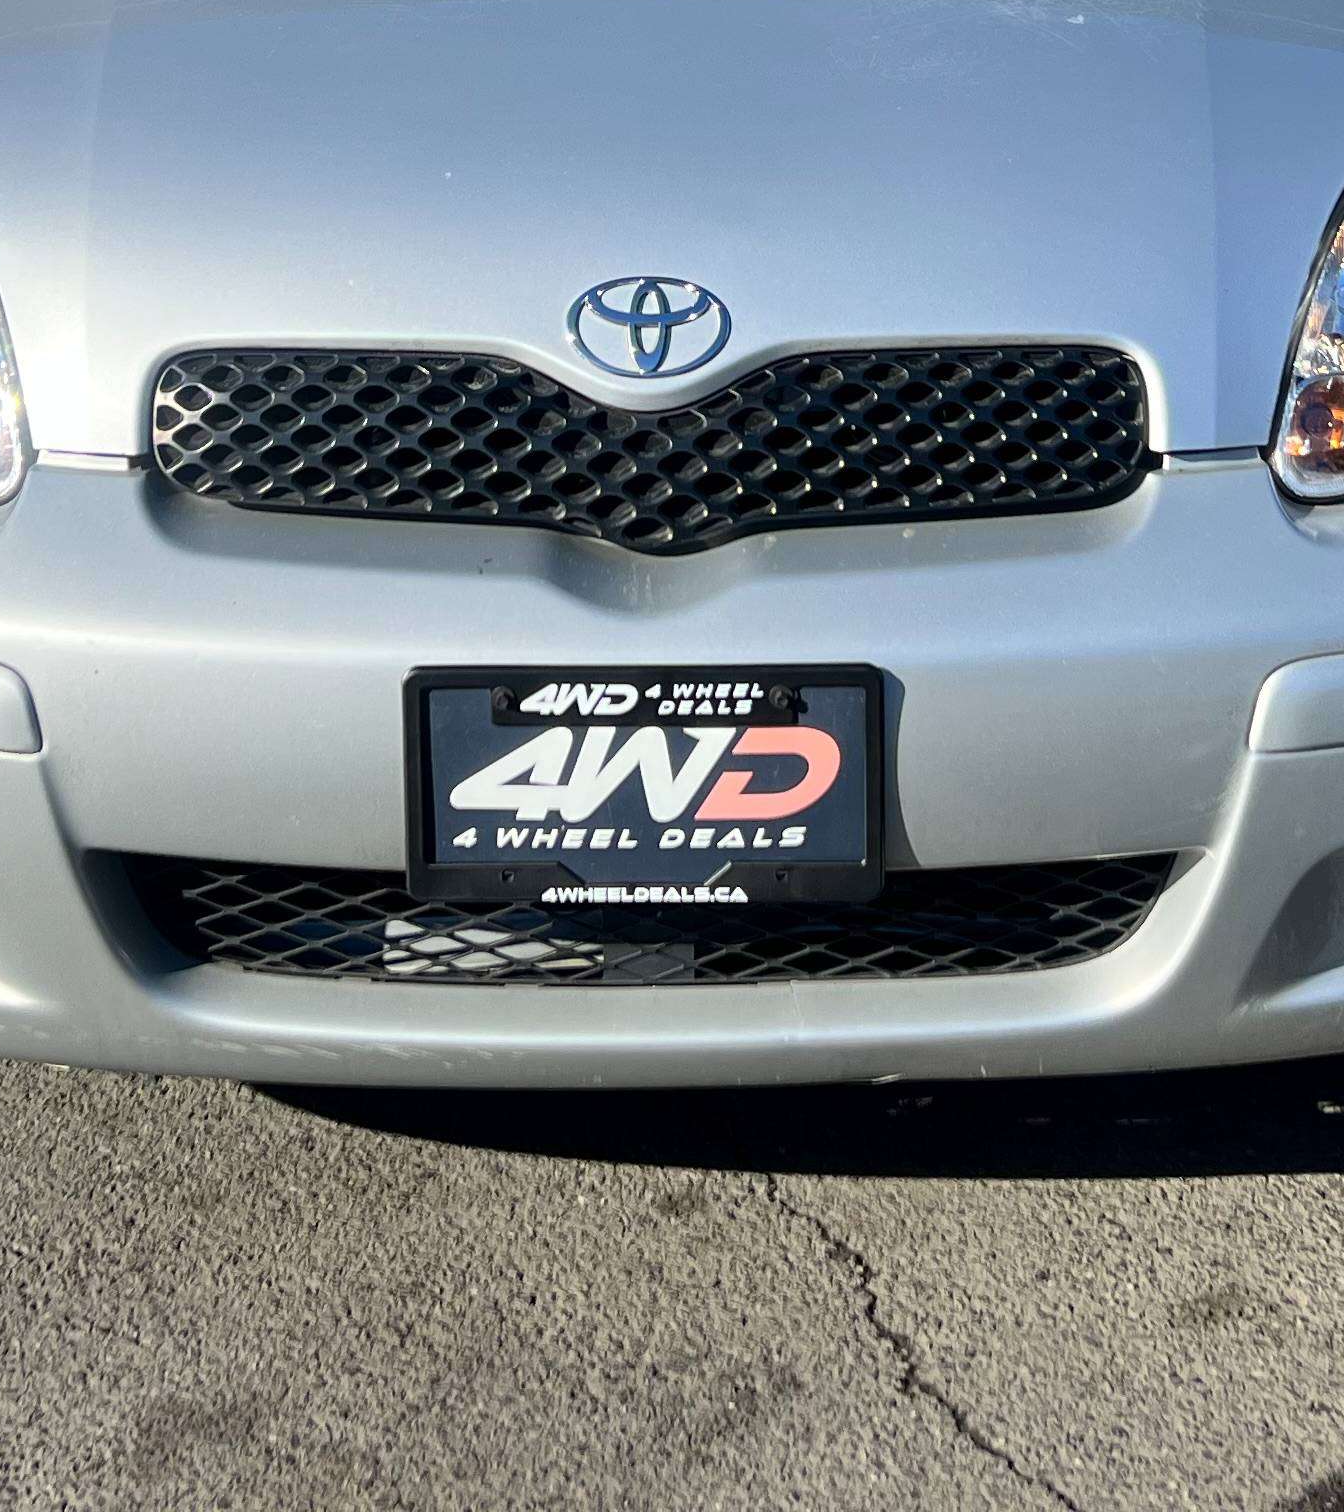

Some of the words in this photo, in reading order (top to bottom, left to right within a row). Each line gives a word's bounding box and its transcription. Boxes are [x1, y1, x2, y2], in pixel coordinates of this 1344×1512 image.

[520, 683, 639, 716] 4WD
[645, 683, 661, 699] 4
[673, 682, 764, 699] WHEEL
[657, 699, 754, 716] DEALS
[449, 726, 842, 824] 4WD
[452, 827, 478, 849] 4
[496, 827, 640, 849] WHEEL
[658, 826, 808, 849] DEALS
[541, 886, 749, 904] 4WHEELDEALS.CA
